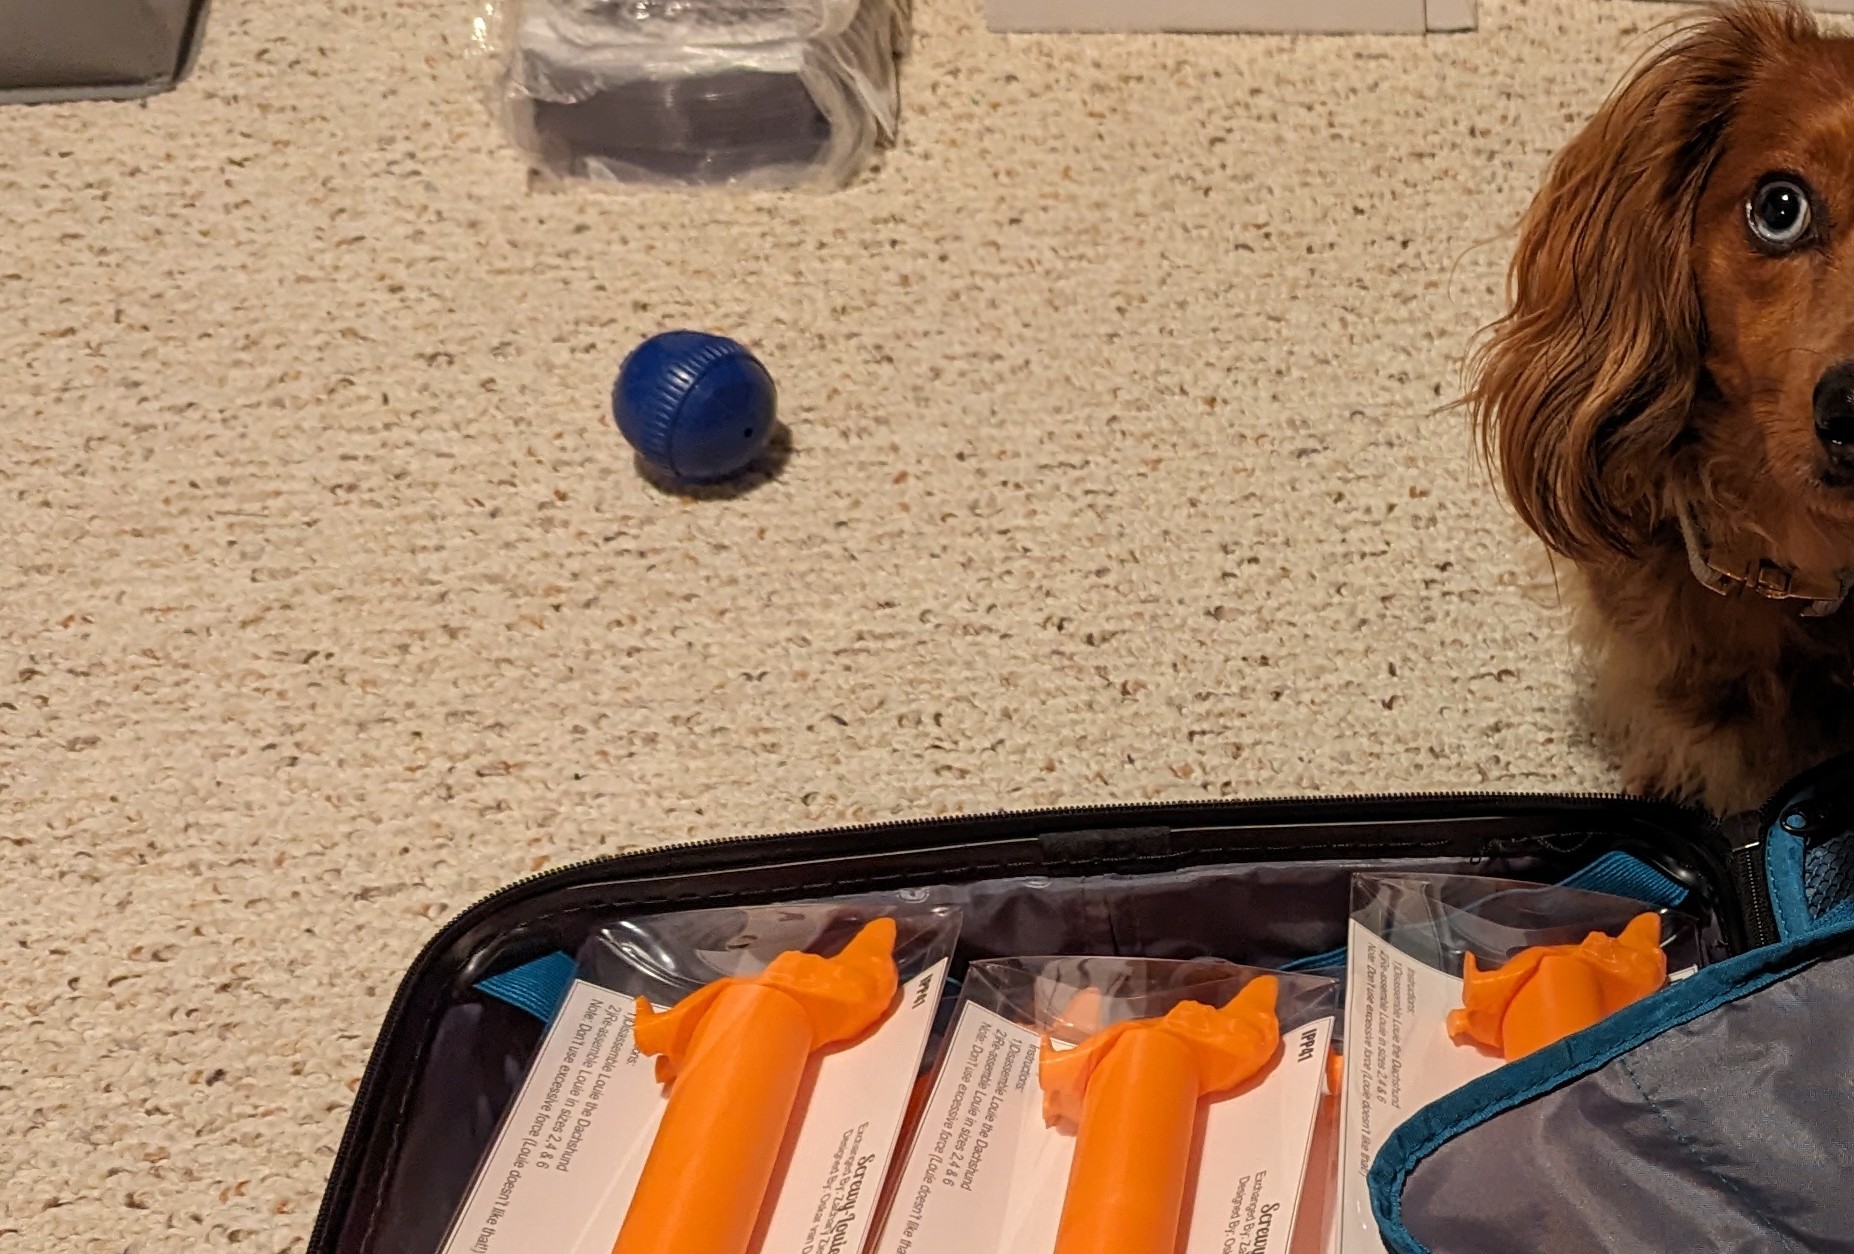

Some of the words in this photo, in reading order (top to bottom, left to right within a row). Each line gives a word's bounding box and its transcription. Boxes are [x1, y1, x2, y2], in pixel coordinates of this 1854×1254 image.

[1297, 1028, 1318, 1063] IPP41
[569, 1069, 593, 1097] Louie
[563, 1097, 580, 1108] in
[552, 1108, 573, 1134] sizes
[544, 1133, 563, 1151] 2,4
[539, 1151, 554, 1160] &
[535, 1160, 550, 1170] 6
